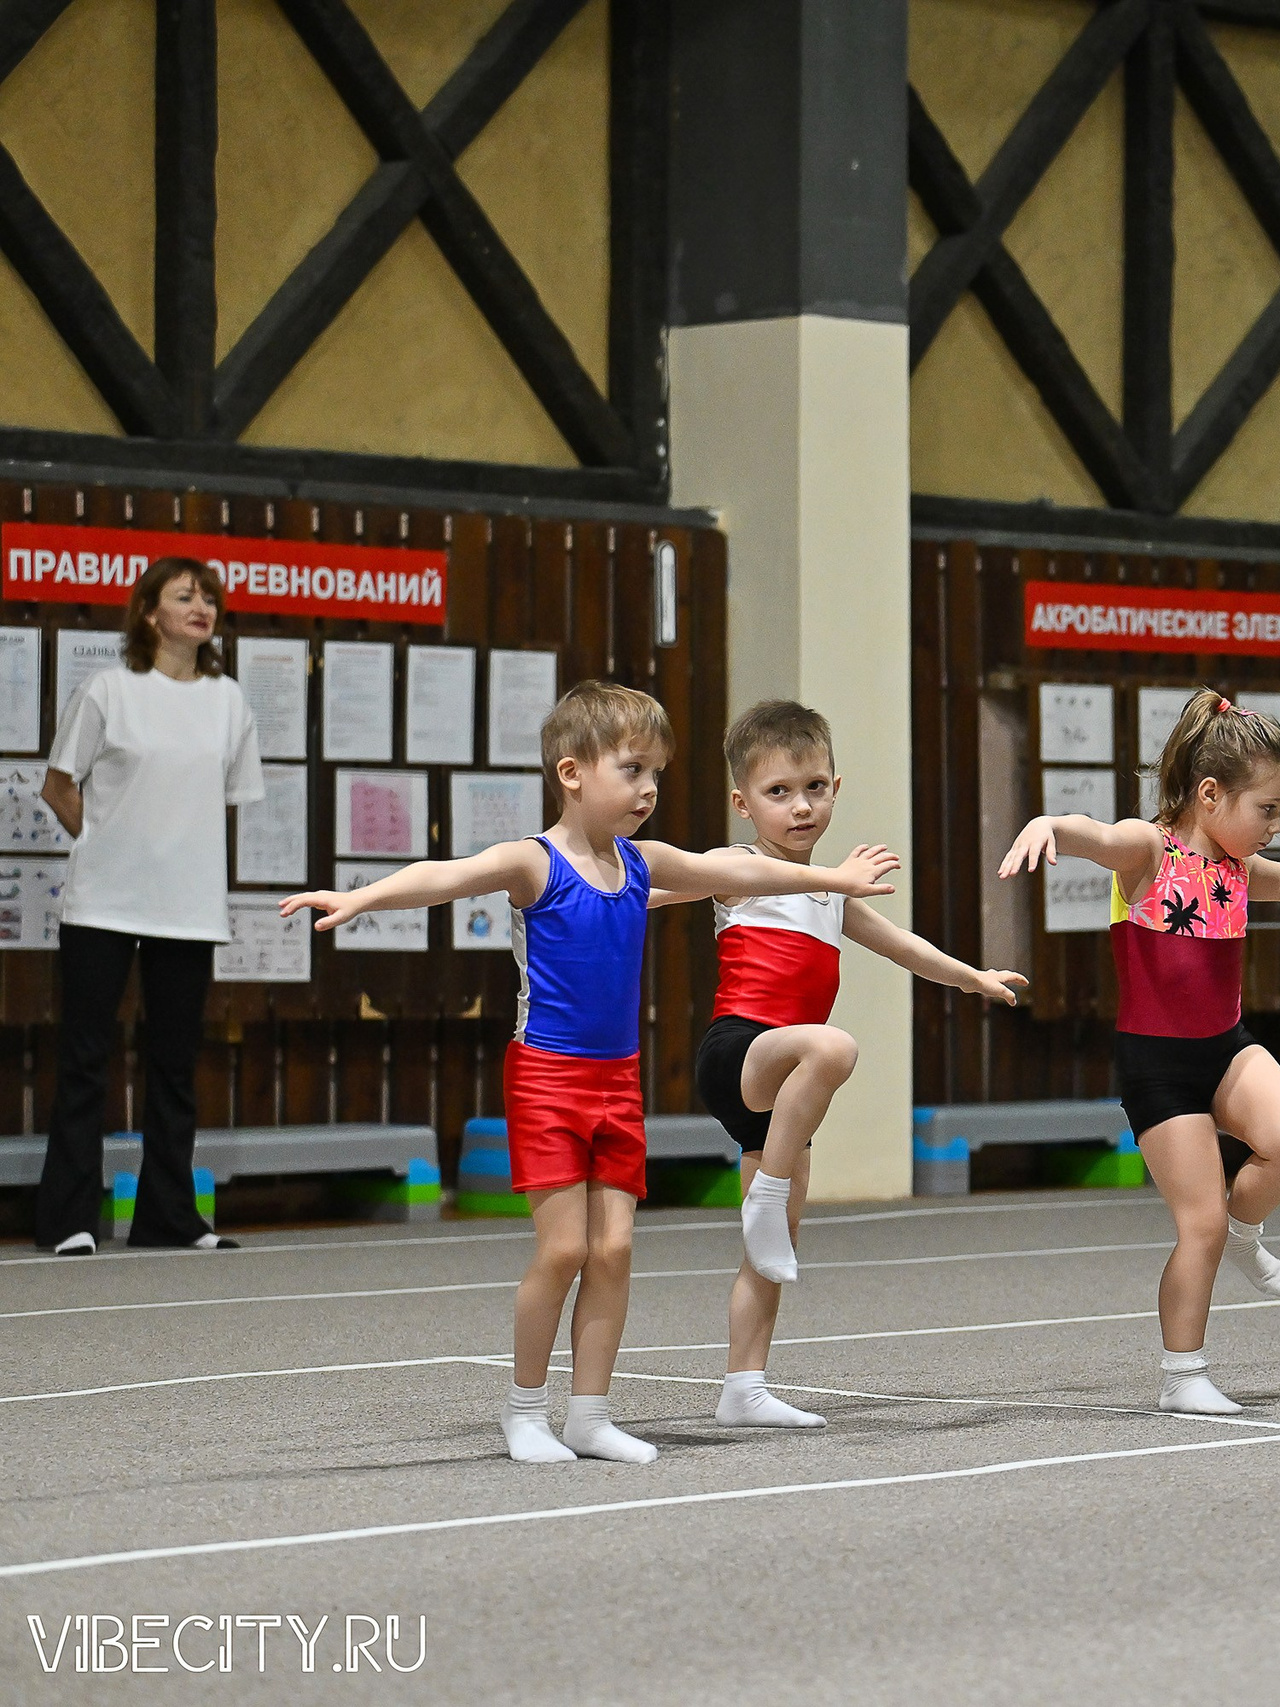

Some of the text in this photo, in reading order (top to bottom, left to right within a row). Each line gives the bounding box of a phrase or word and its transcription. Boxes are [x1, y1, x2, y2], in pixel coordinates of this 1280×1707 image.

[9, 548, 443, 606] ПРАВИЛ ОРЕВНОВАНИЙ
[1031, 603, 1230, 639] АКРОБАТИЧЕСКИЕ
